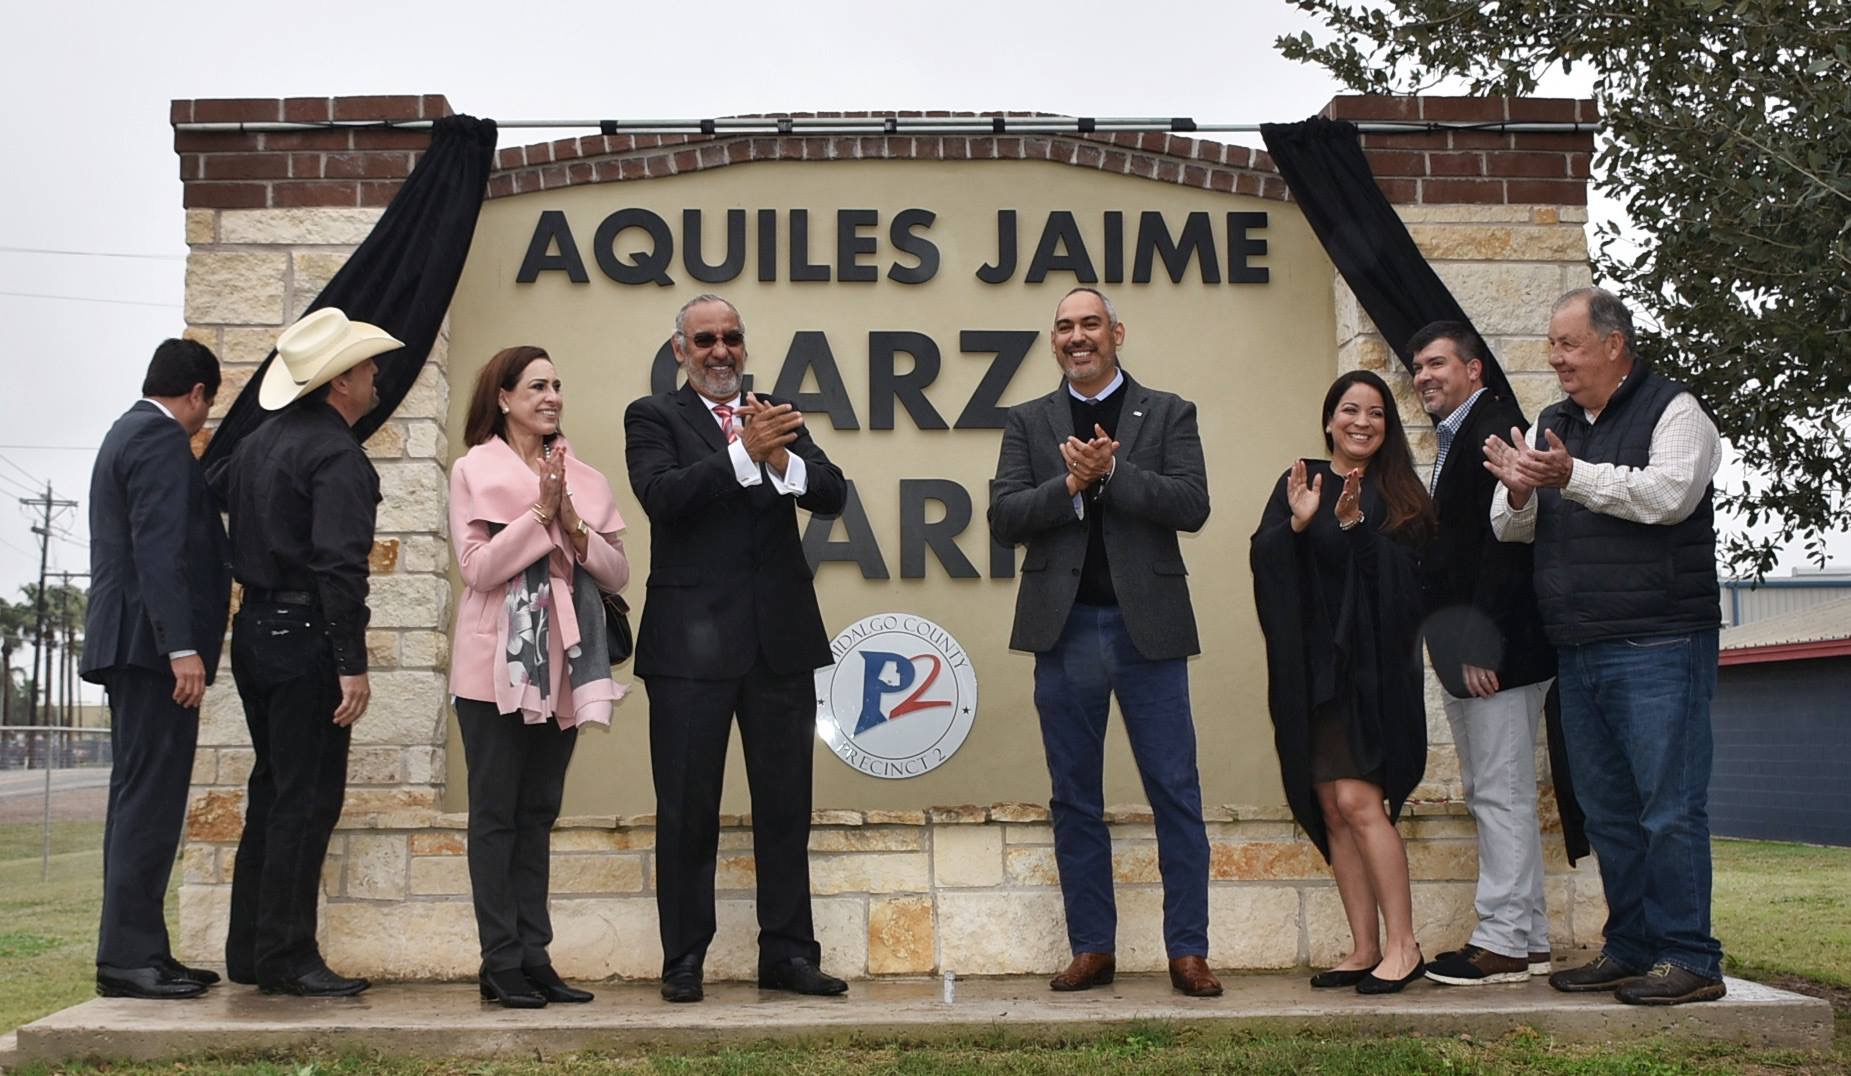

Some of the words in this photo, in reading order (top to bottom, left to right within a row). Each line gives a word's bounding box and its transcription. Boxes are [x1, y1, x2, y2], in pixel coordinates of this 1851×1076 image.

[516, 208, 941, 286] AQUILES
[976, 209, 1270, 284] JAIME
[650, 330, 1122, 430] ARZ
[903, 616, 969, 669] COUNTY
[853, 650, 952, 737] P2
[836, 742, 928, 776] PRECINCT
[933, 748, 946, 762] 2
